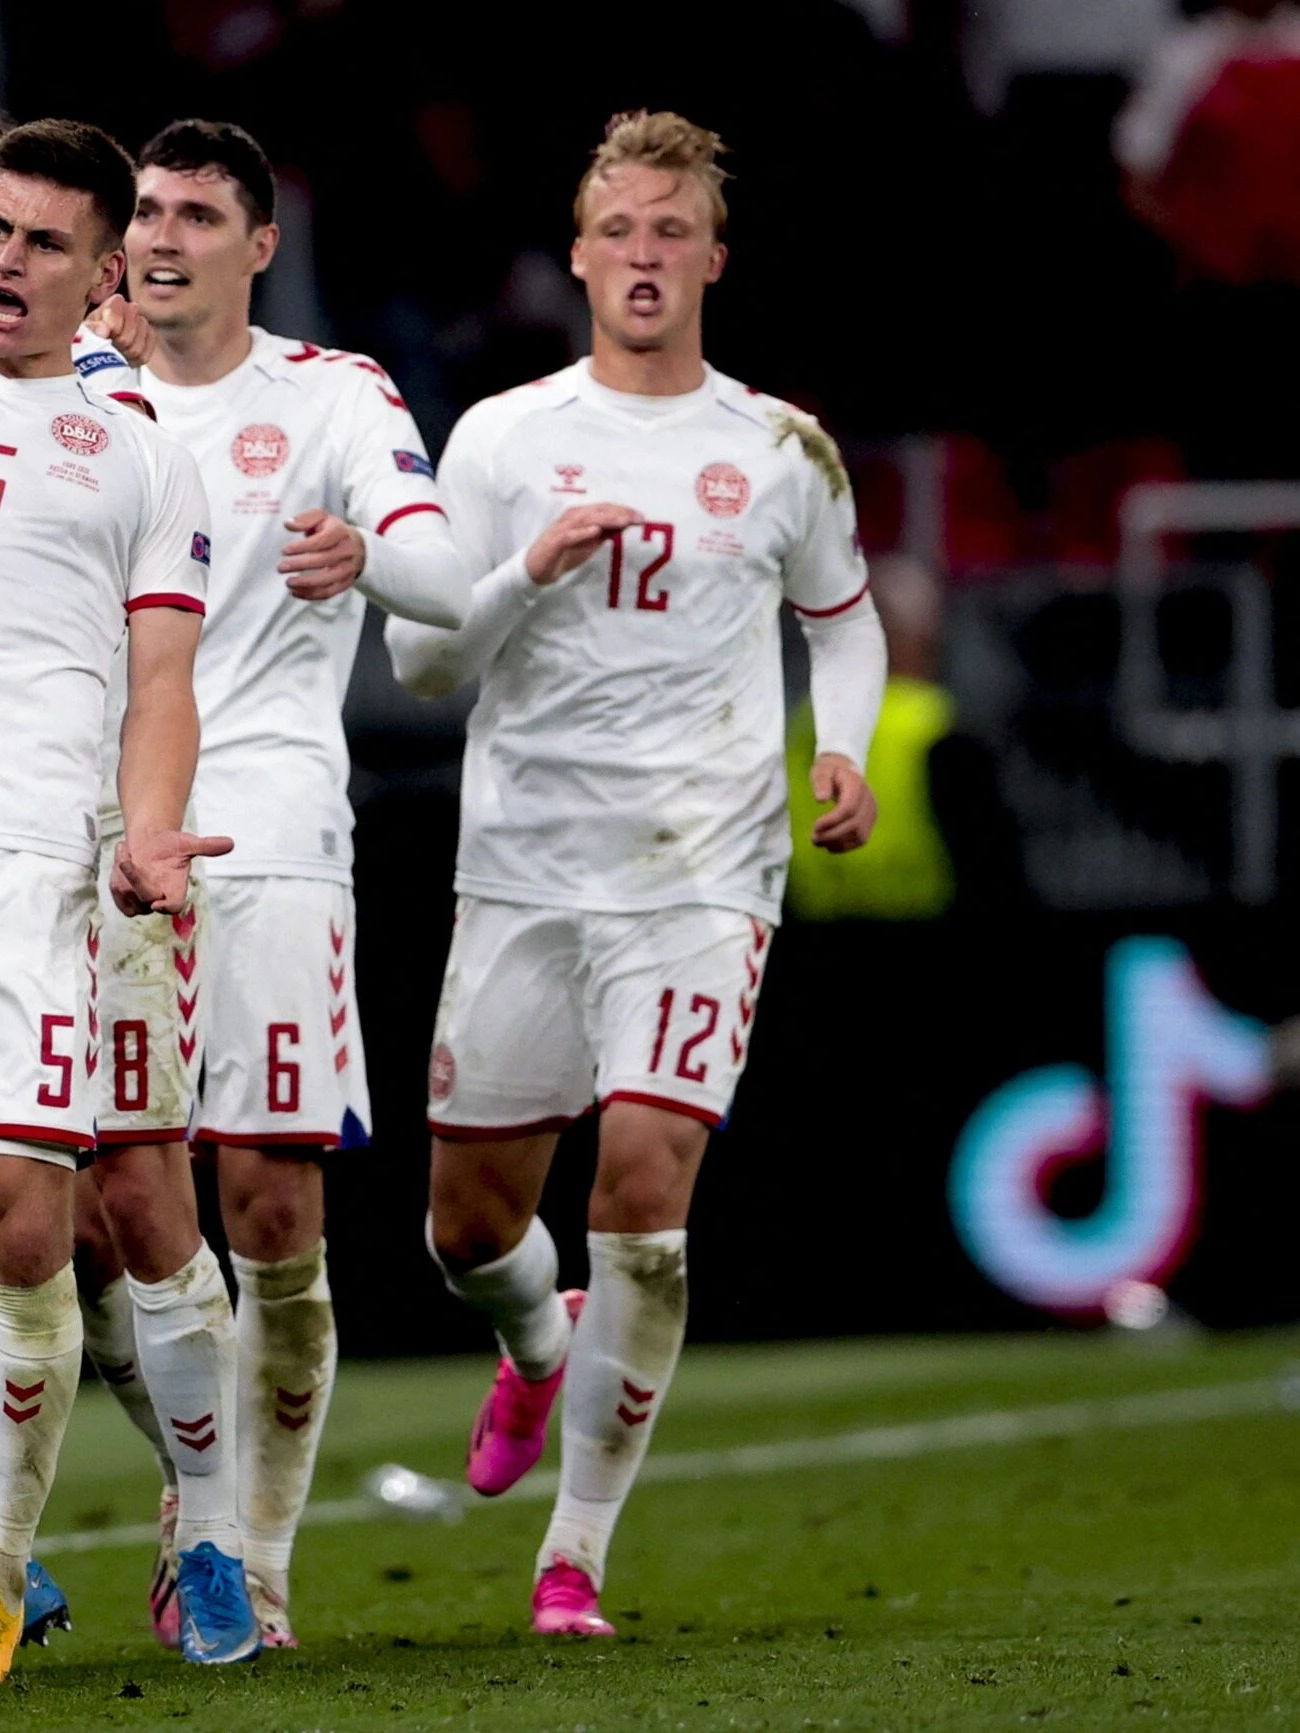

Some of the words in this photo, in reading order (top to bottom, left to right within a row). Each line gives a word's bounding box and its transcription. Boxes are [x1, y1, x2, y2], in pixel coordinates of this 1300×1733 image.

[602, 522, 675, 612] 12
[37, 1014, 75, 1109] 5
[113, 1019, 149, 1112] 8
[267, 1022, 301, 1113] 6
[649, 987, 721, 1084] 12
